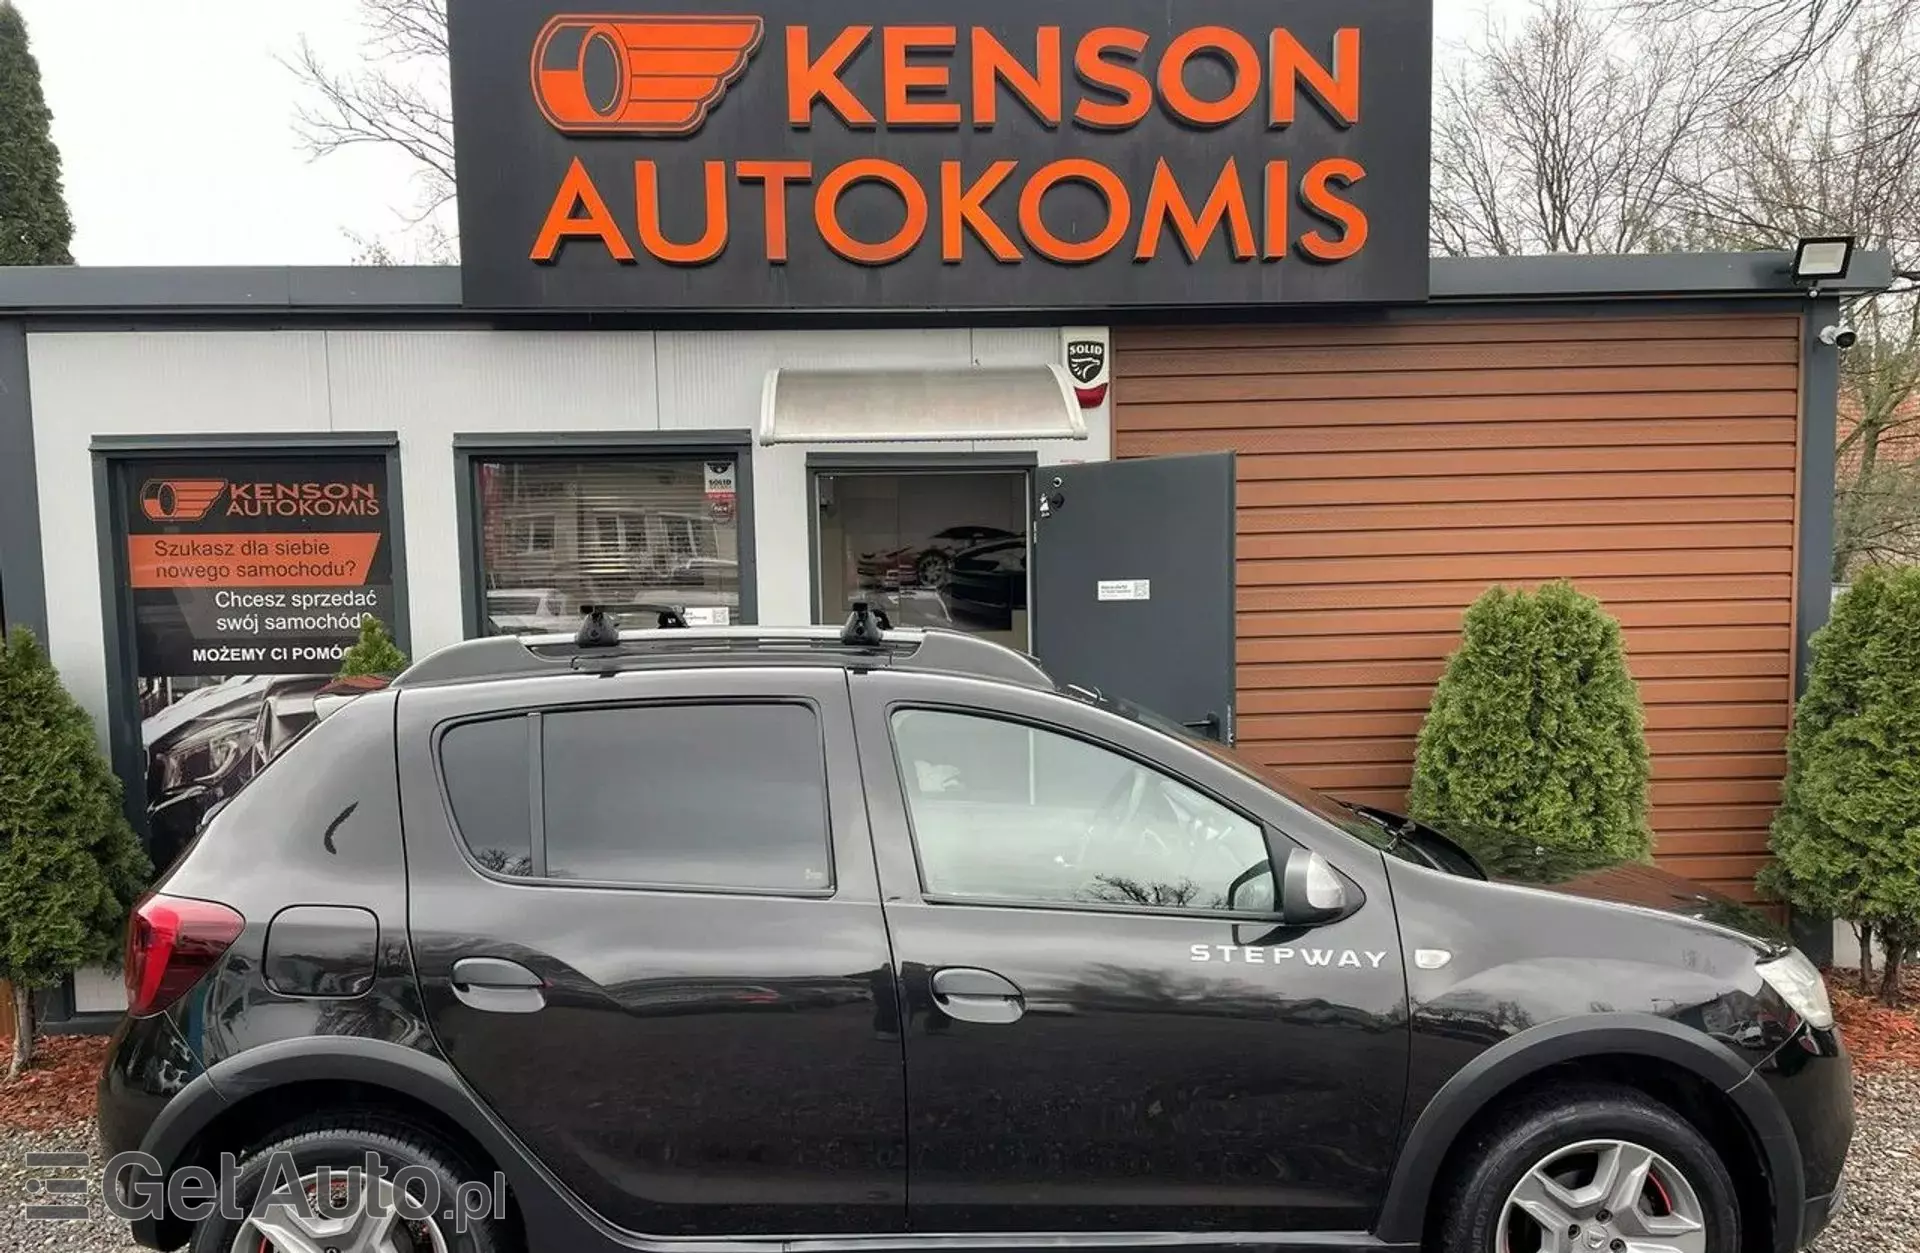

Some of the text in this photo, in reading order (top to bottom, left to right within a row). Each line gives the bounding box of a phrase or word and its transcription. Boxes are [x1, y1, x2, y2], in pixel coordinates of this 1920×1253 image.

[785, 25, 1361, 129] KENSON
[529, 156, 1369, 264] AUTOKOMIS
[1069, 344, 1103, 354] SOLID
[229, 483, 375, 500] KENSON
[226, 500, 380, 517] AUTOKOMIS
[154, 539, 330, 557] Szukasz dla siebie
[156, 561, 356, 581] nowego samochodu?
[215, 590, 377, 610] Chcesz sprzedać
[216, 615, 260, 635] swój
[193, 646, 266, 662] MOŻEMY
[271, 648, 288, 661] CI
[1190, 944, 1387, 968] STEPWAY
